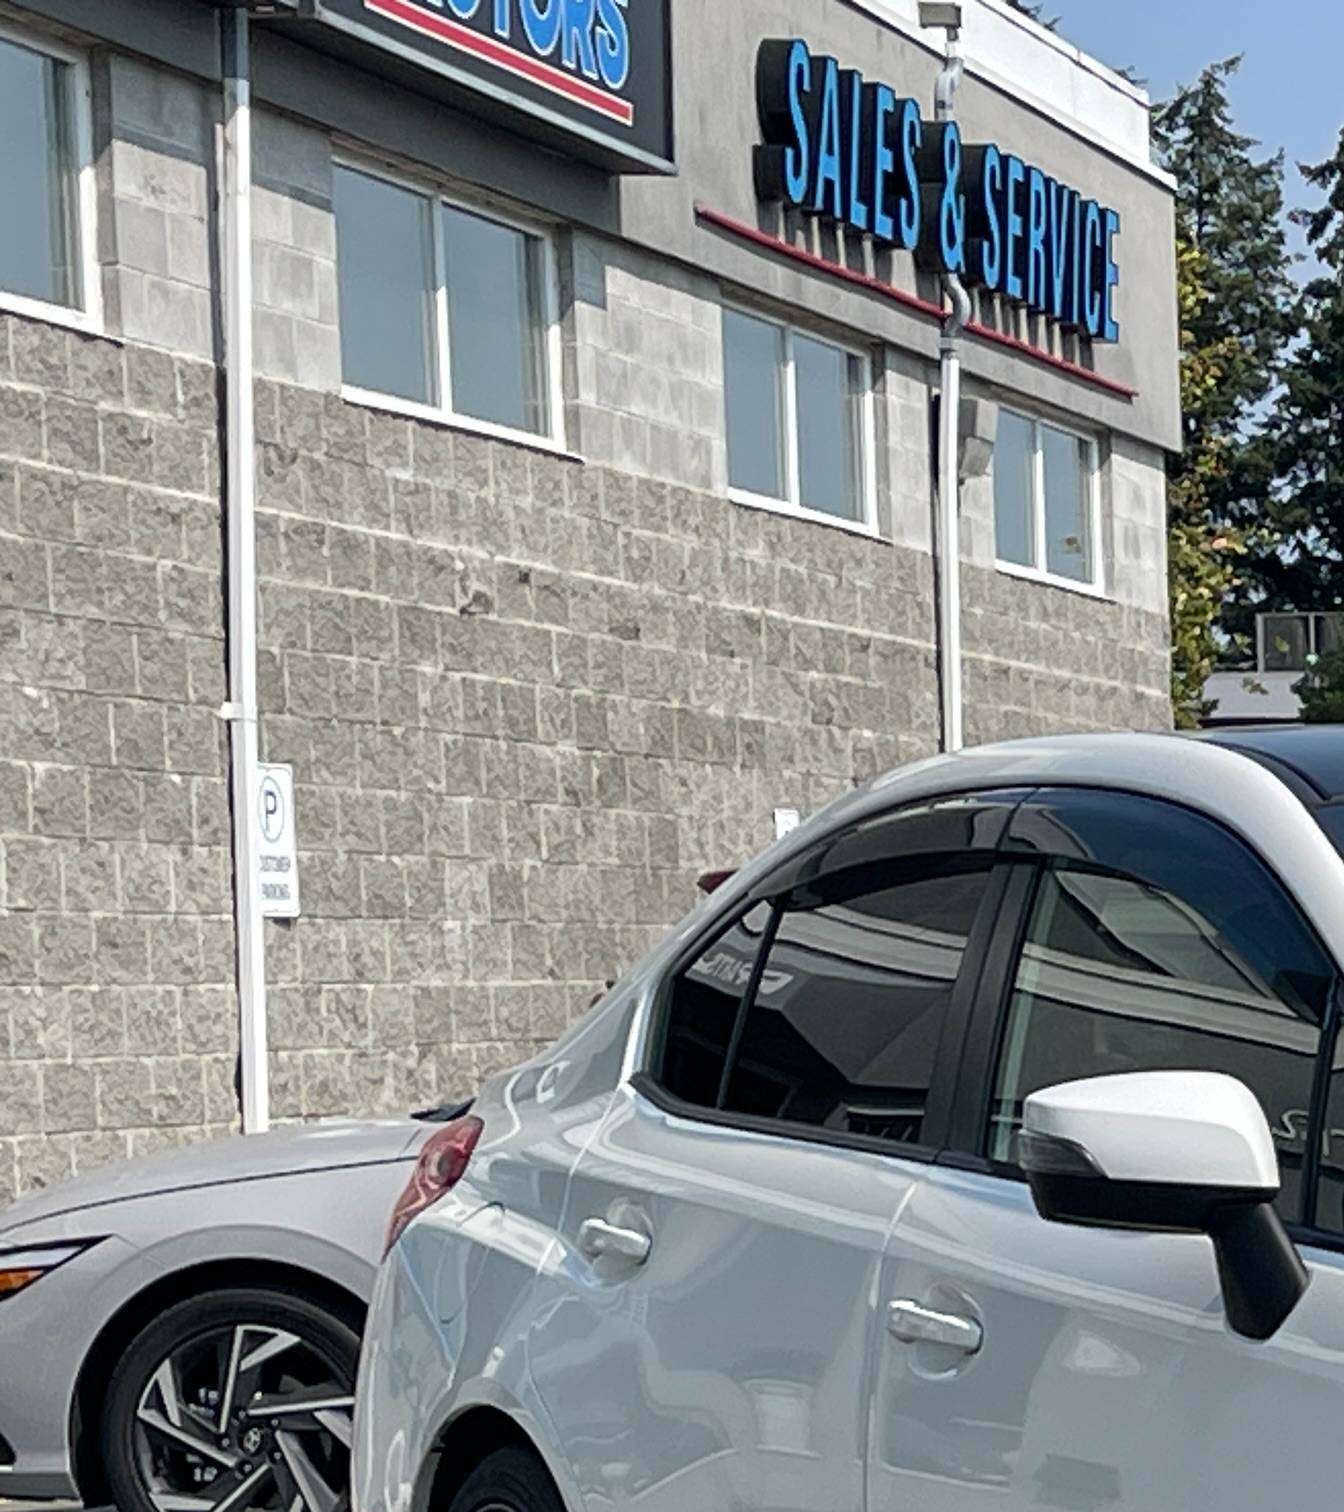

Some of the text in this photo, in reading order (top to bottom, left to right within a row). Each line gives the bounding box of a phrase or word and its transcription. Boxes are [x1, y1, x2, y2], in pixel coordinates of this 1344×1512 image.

[784, 37, 1121, 344] SALES & SERVICE
[265, 790, 277, 832] P
